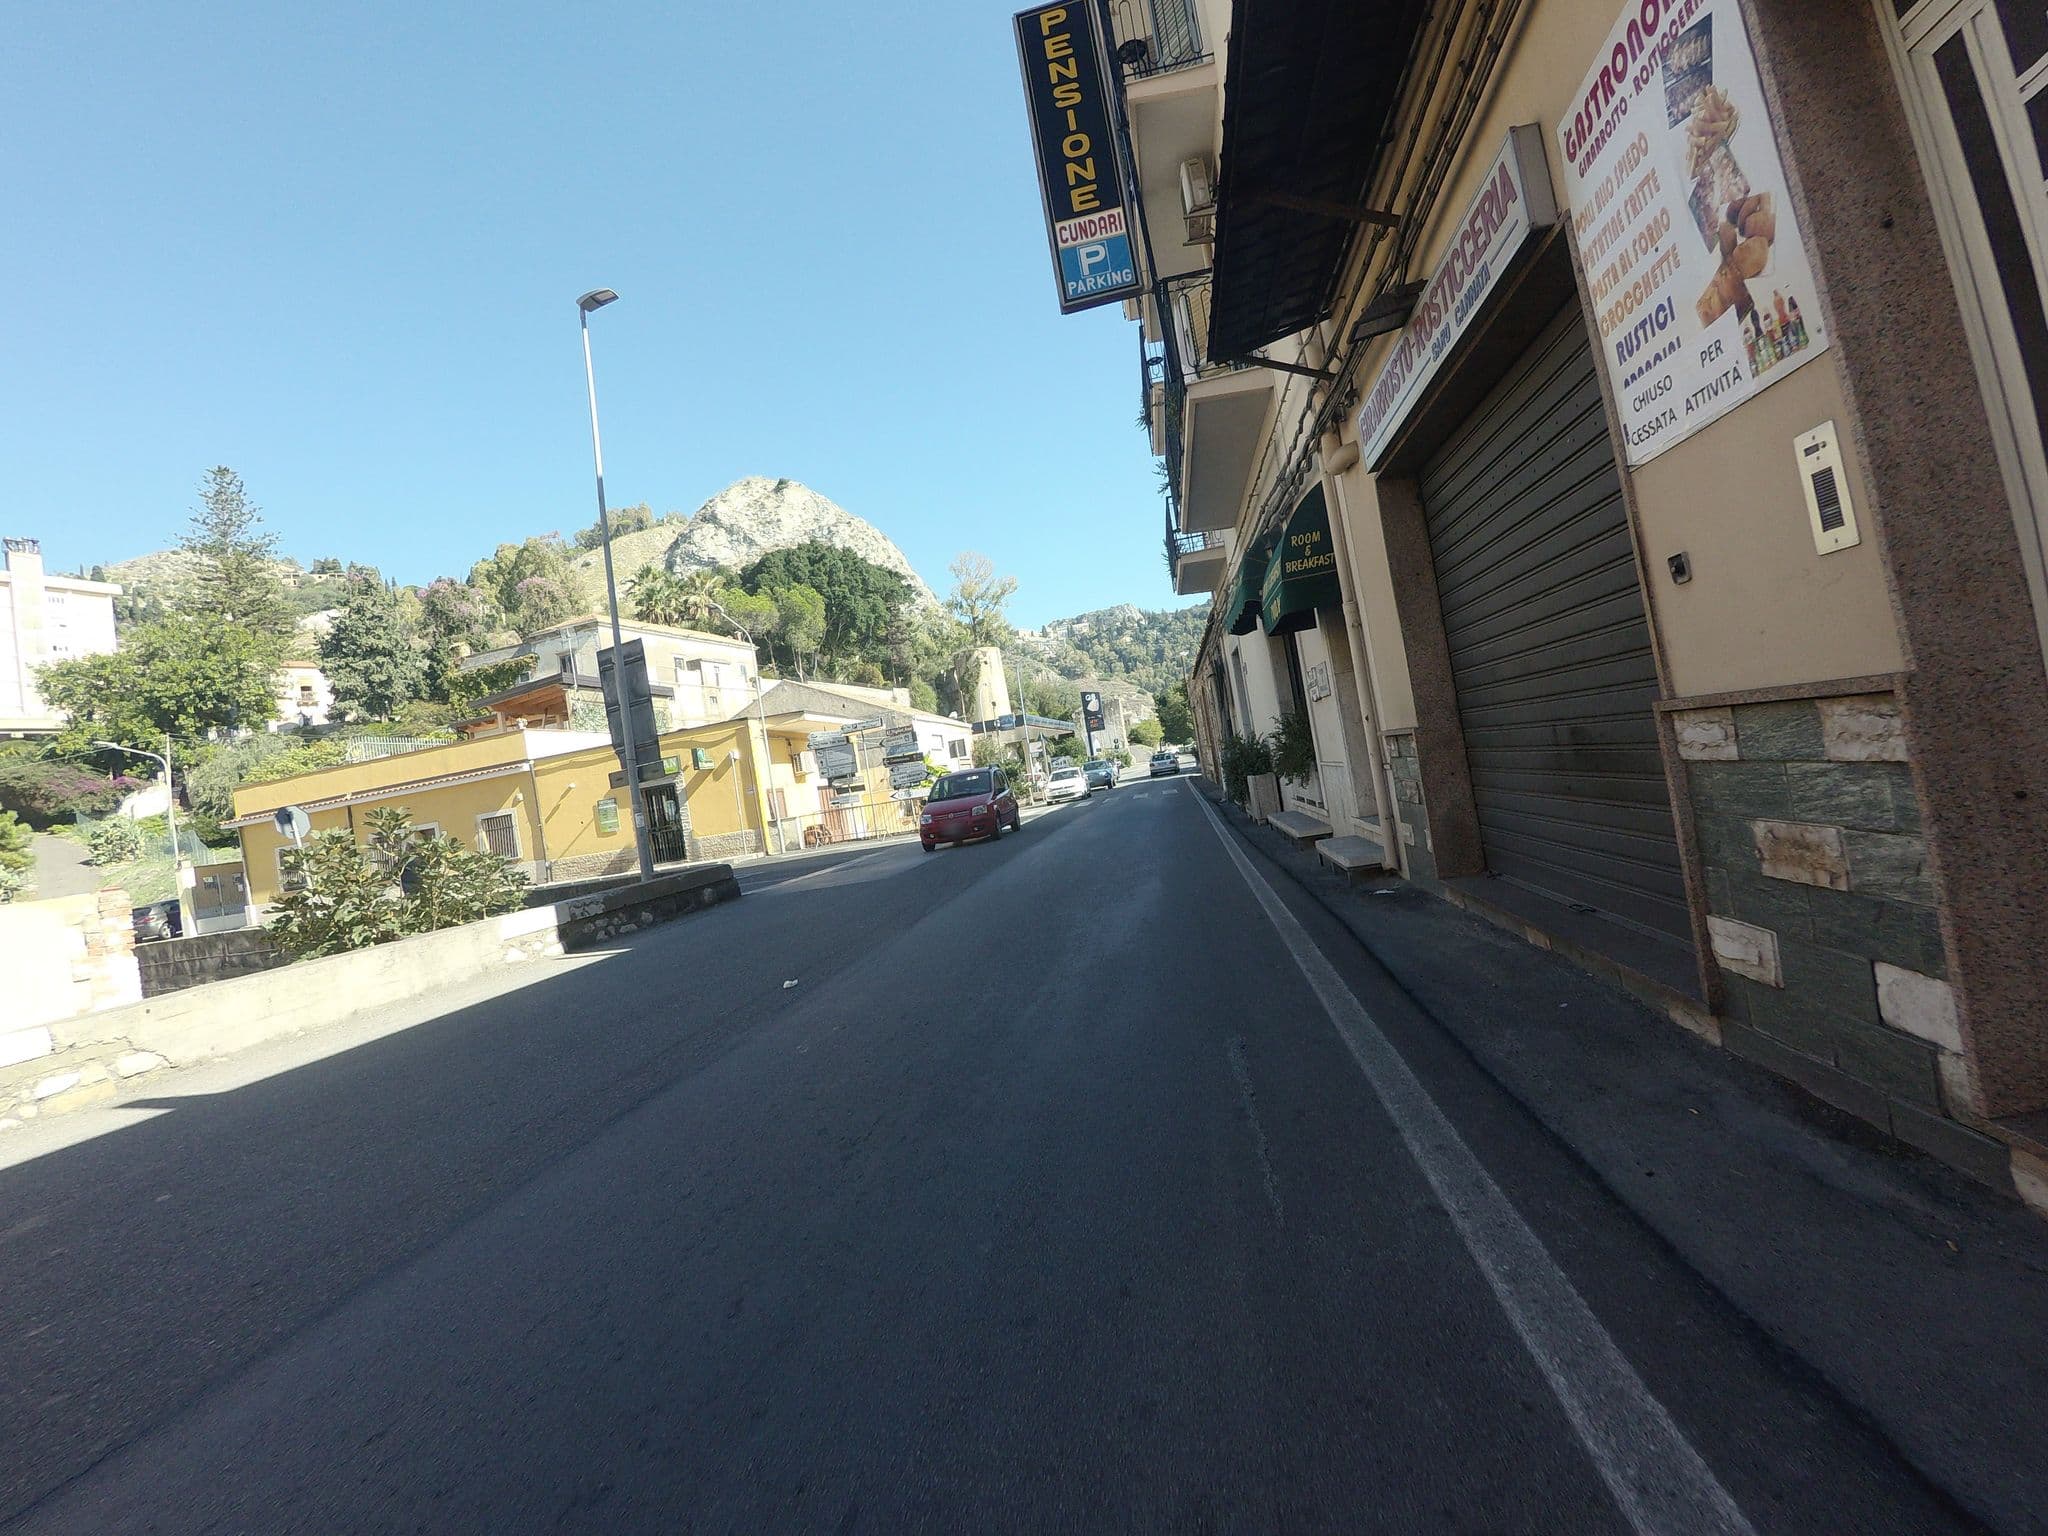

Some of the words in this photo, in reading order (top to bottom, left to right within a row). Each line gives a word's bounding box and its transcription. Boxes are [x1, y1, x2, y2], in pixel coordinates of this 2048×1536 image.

[1040, 7, 1101, 214] PENSIONE
[1564, 0, 1675, 163] GASTRONO
[1579, 96, 1628, 178] GIRARROSTO
[1574, 199, 1596, 241] POLLI
[1595, 176, 1615, 214] ALLO
[1614, 132, 1649, 190] SPIEDO
[1583, 209, 1625, 275] PATATINE
[1624, 167, 1661, 225] FRITTE
[1060, 211, 1125, 245] CUNDARI
[1081, 244, 1107, 277] P
[1591, 263, 1620, 307] PASTA
[1618, 248, 1633, 276] AL
[1632, 207, 1670, 263] FORNO
[1067, 268, 1134, 298] PARKING
[1600, 243, 1680, 337] CROCCHETTE
[1616, 295, 1676, 367] RUSTICI
[1631, 408, 1678, 446] CESSATA
[1684, 360, 1743, 416] ATTIVITÀ
[1633, 375, 1673, 413] CHIUSO
[1700, 339, 1725, 369] PER
[1285, 553, 1336, 573] BREAKFAST
[1291, 531, 1321, 547] ROOM
[1305, 545, 1312, 557] &
